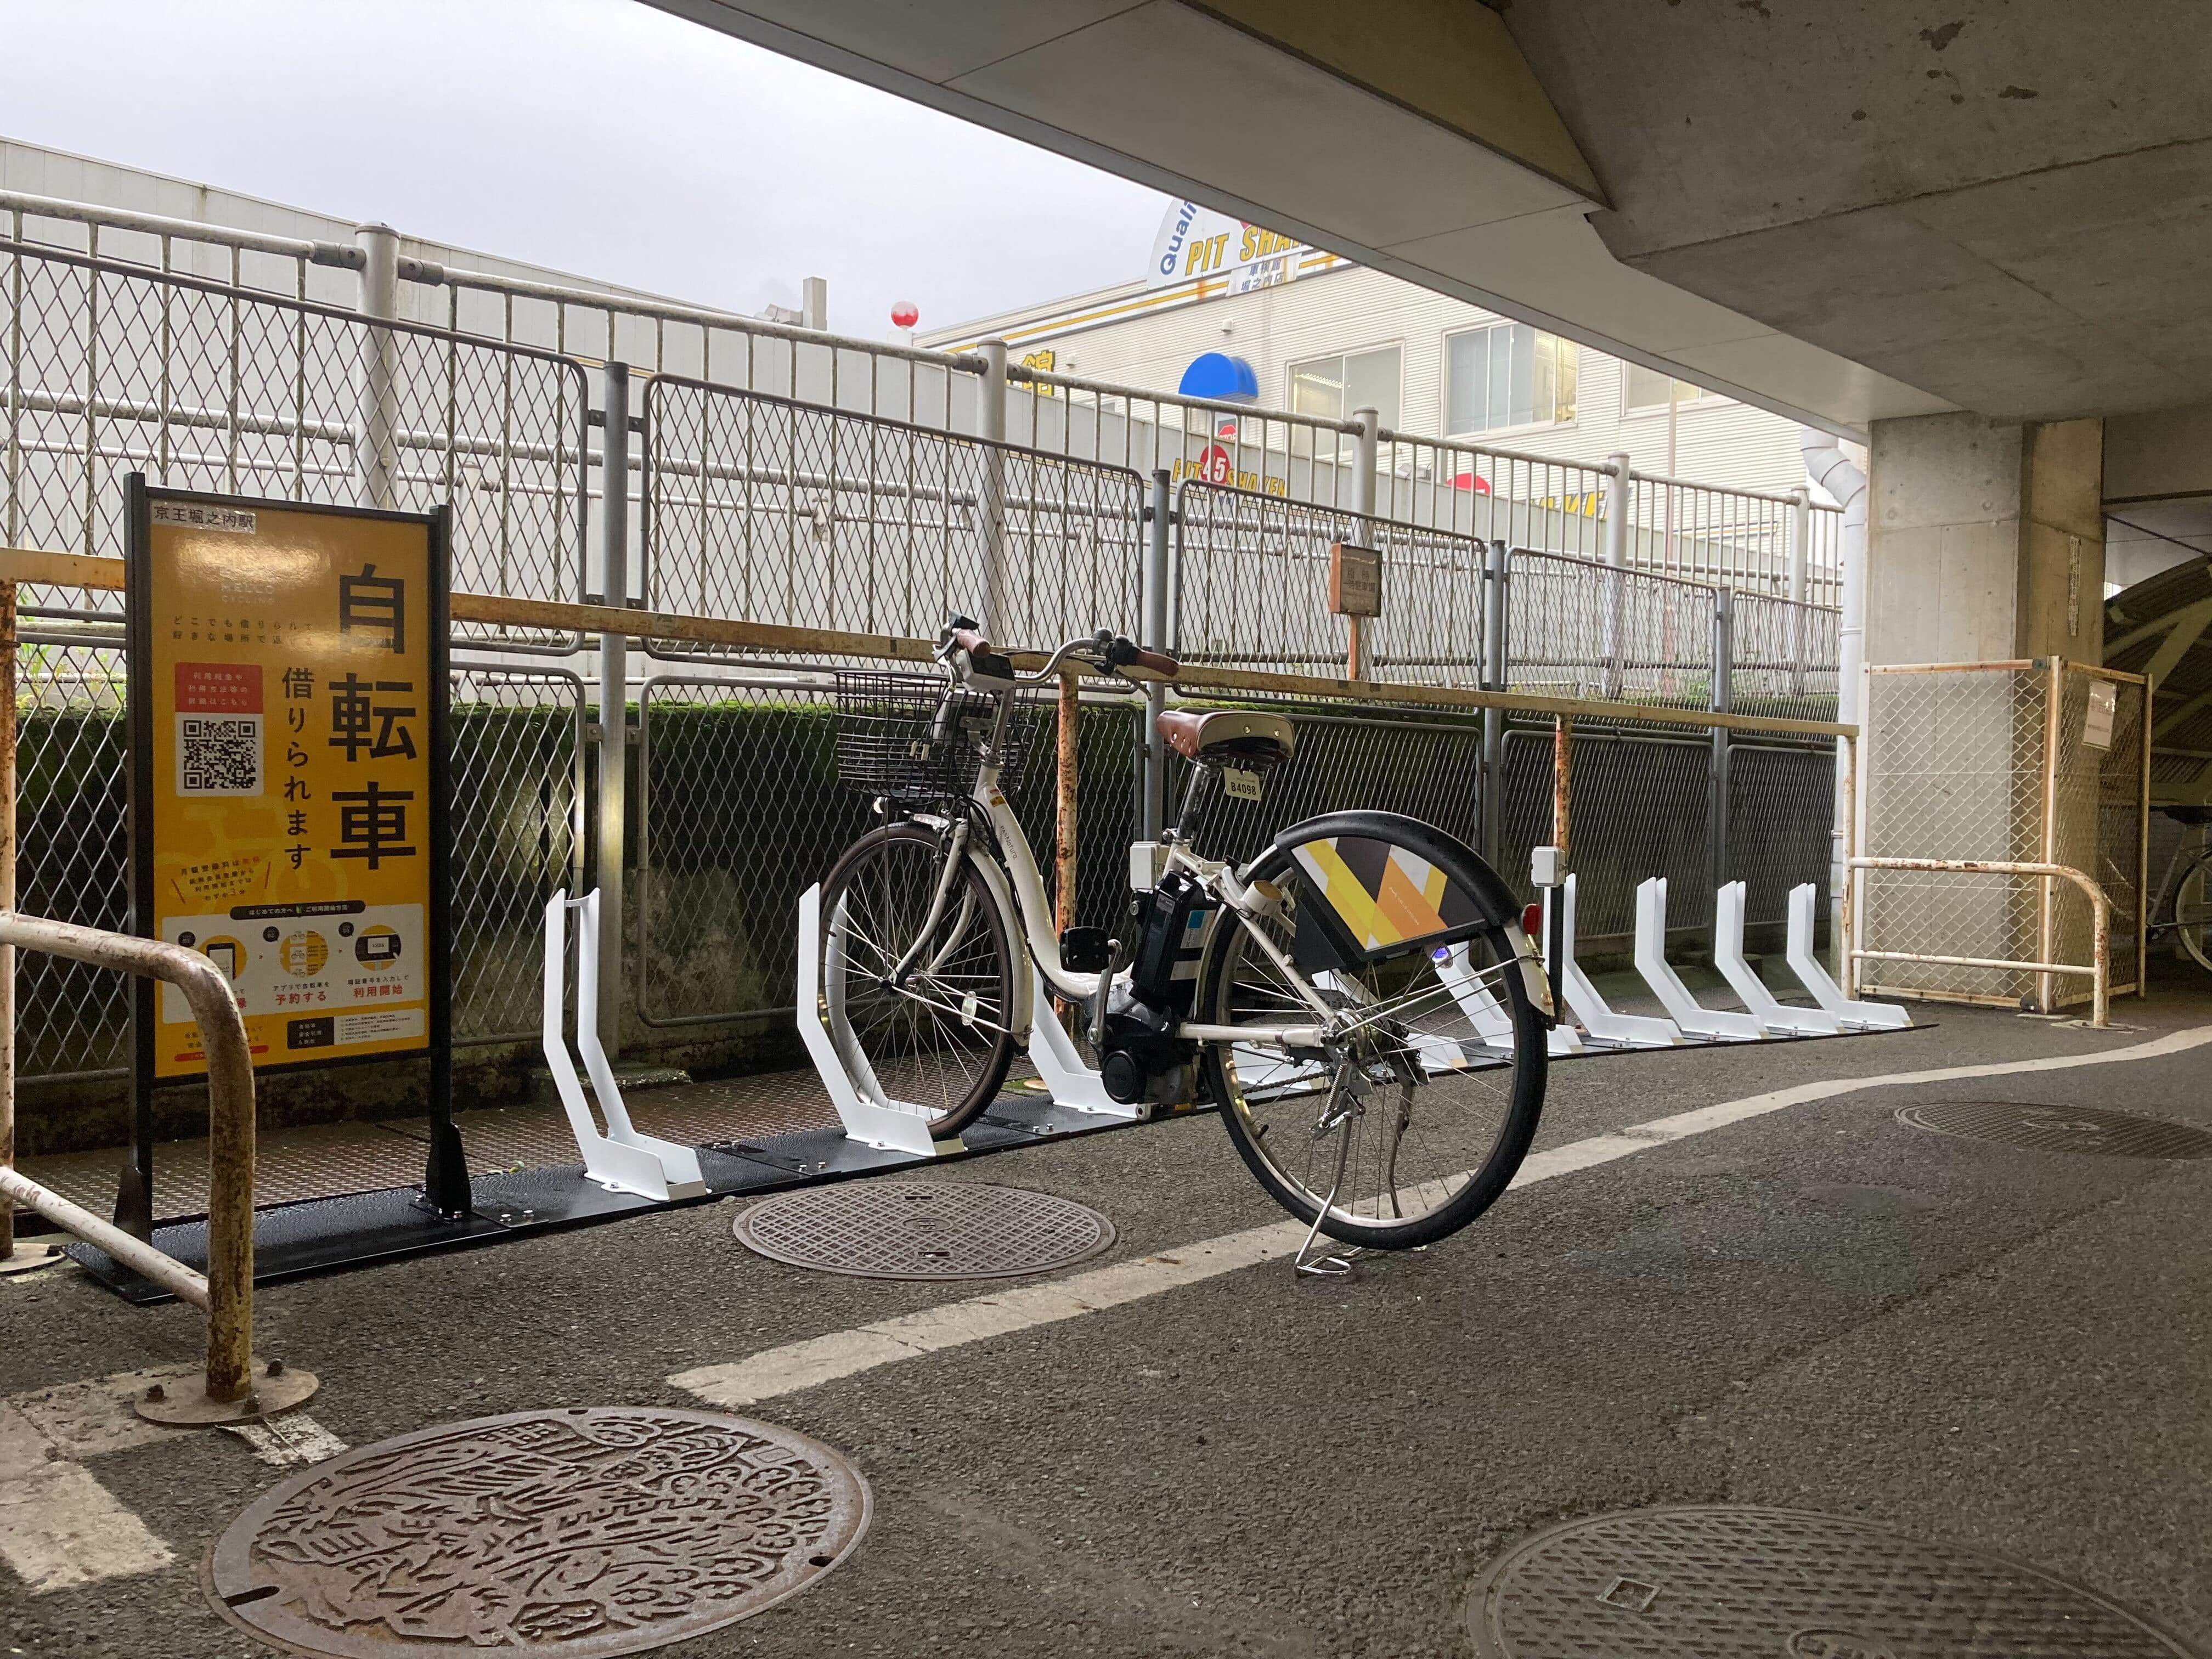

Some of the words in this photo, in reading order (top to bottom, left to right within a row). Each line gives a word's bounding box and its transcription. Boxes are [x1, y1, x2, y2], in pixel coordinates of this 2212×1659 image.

[1184, 232, 1230, 276] PIT
[1241, 272, 1284, 292] 堀之内店
[154, 505, 253, 528] 京王堀之内駅
[329, 563, 417, 871] 自転車
[281, 667, 316, 870] 借りられます
[1231, 782, 1256, 795] B4098
[275, 991, 327, 1005] 予約する
[353, 984, 403, 998] 利用開始
